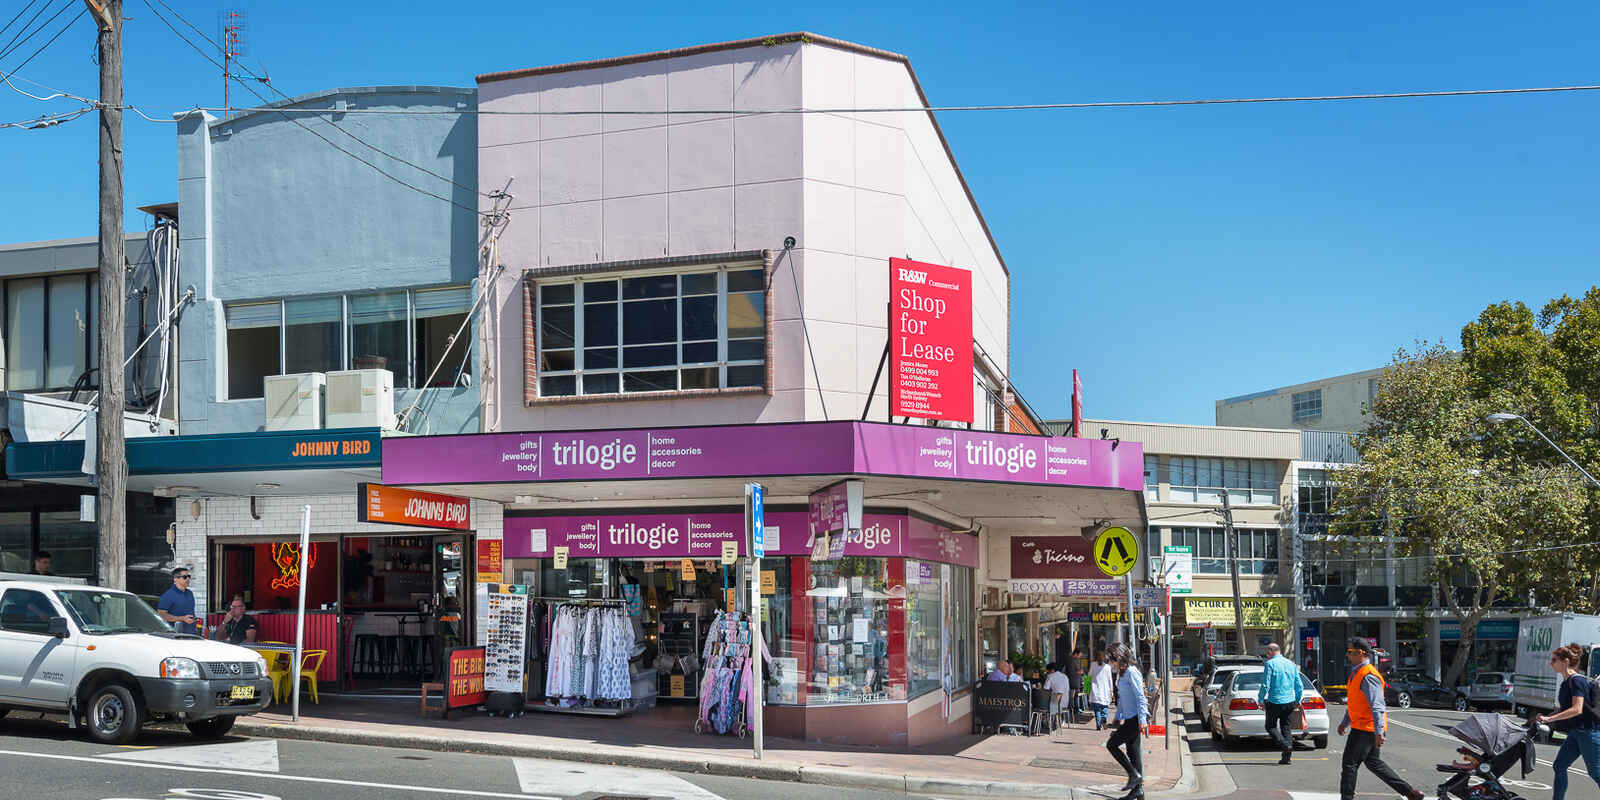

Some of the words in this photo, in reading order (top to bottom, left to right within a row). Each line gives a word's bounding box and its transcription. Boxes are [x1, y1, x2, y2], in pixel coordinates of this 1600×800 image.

[898, 268, 928, 284] R&W
[900, 288, 946, 319] Shop
[900, 311, 928, 335] for
[901, 336, 955, 363] Lease
[520, 440, 537, 450] gifts
[651, 436, 675, 445] home
[936, 436, 952, 446] gifts
[292, 441, 339, 457] JOHNNY
[342, 440, 371, 455] BIRD
[651, 447, 702, 456] accessories
[920, 447, 952, 458] jewellery
[1048, 445, 1067, 454] home
[502, 451, 537, 463] jewellery
[552, 438, 637, 470] trilogie
[966, 440, 1037, 474] trilogie
[651, 459, 676, 468] decor
[934, 460, 952, 470] body
[1048, 456, 1088, 466] accessories
[517, 463, 537, 473] body
[404, 498, 444, 521] JOHNNY
[446, 503, 467, 524] BIRD
[581, 522, 596, 532] gifts
[692, 522, 711, 530] home
[566, 532, 596, 542] jewellery
[608, 523, 679, 550] trilogie
[692, 531, 733, 539] accessories
[579, 541, 596, 551] body
[692, 541, 712, 549] decor
[1044, 549, 1085, 565] Ticino
[1012, 582, 1059, 593] ECOYA
[1067, 581, 1099, 590] 25%
[1189, 601, 1228, 609] PICTURE
[1229, 601, 1269, 609] FAMING
[1092, 613, 1121, 622] MONEY
[1124, 613, 1144, 622] LNT
[453, 658, 468, 675] THE
[452, 679, 468, 696] THE
